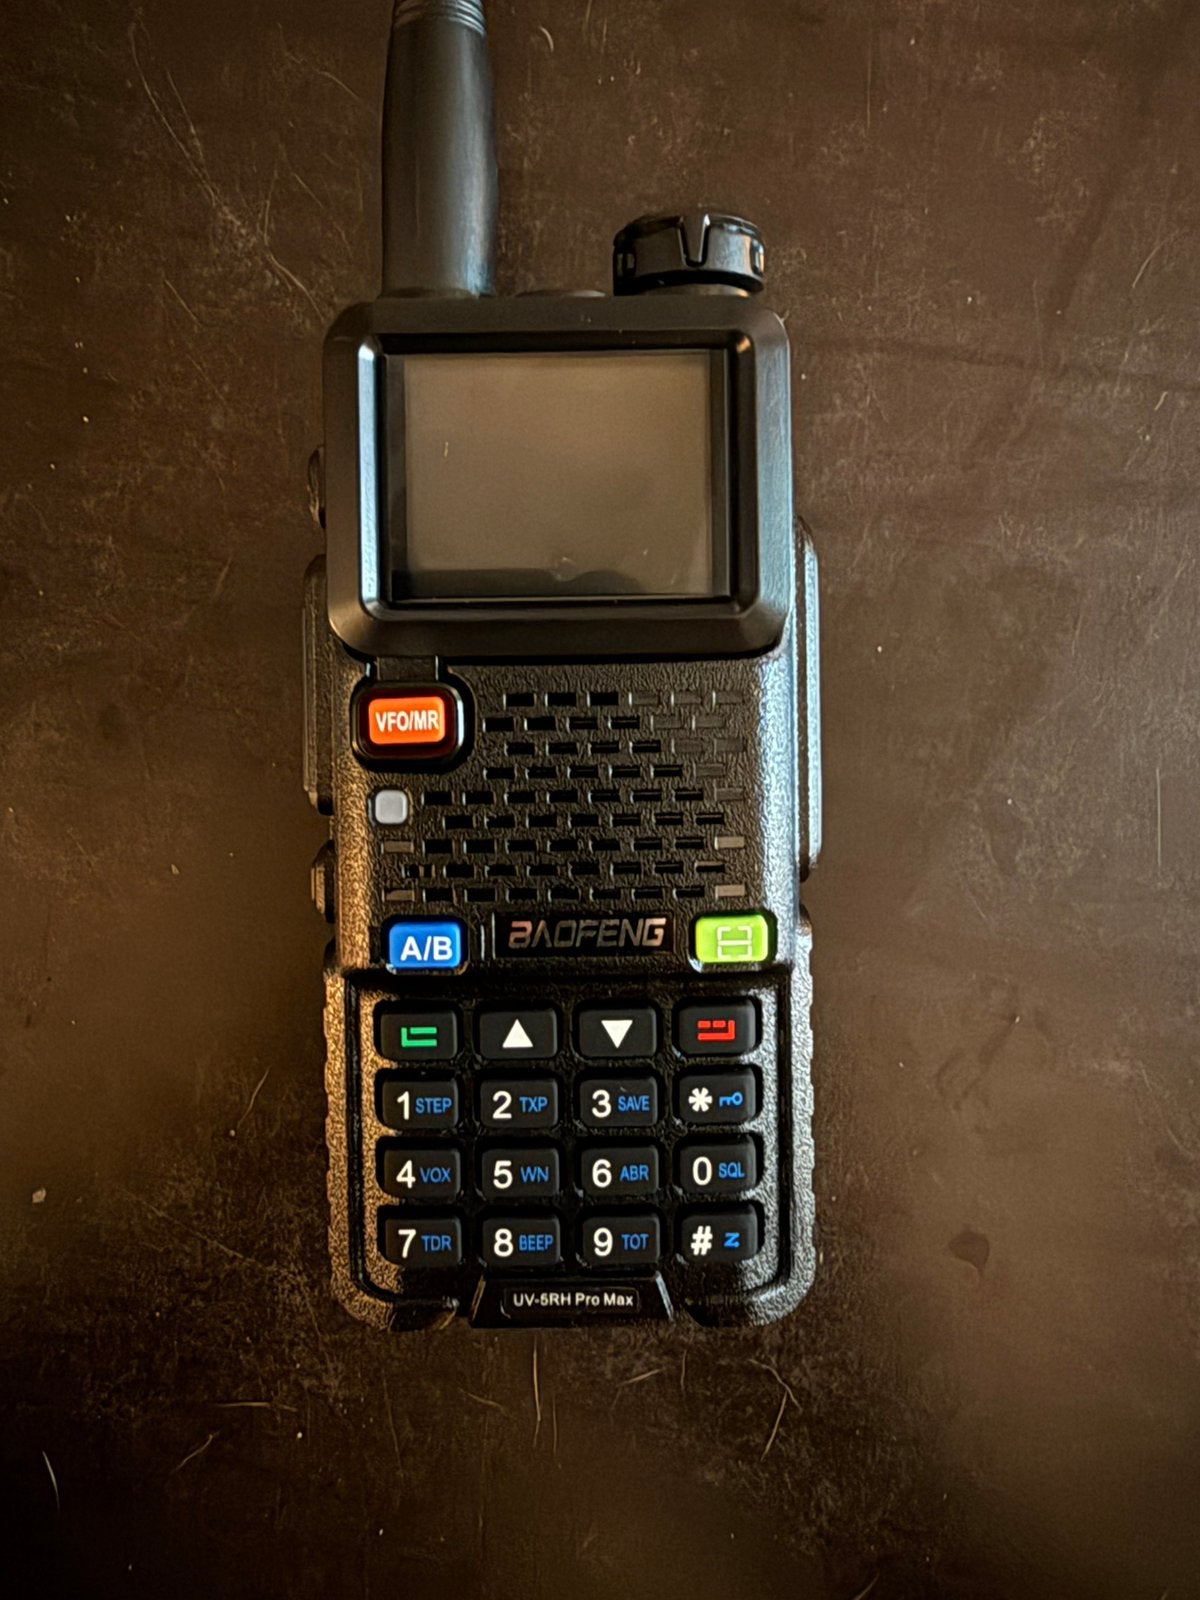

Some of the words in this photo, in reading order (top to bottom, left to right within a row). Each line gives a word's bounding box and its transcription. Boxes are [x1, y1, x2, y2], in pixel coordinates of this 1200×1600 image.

[375, 709, 439, 731] VFO/MR
[400, 936, 452, 961] A/B
[396, 1091, 411, 1120] 1
[415, 1097, 452, 1113] STEP
[492, 1091, 512, 1120] 2
[519, 1097, 548, 1113] TXP
[591, 1090, 612, 1118] 3
[618, 1095, 649, 1112] SAVE
[396, 1160, 416, 1188] 4
[420, 1167, 451, 1183] VOX
[493, 1160, 513, 1189] 5
[520, 1166, 549, 1182] WN
[592, 1159, 612, 1188] 6
[619, 1165, 649, 1181] ABR
[692, 1157, 712, 1185] 0
[718, 1162, 745, 1178] SQL
[398, 1229, 416, 1258] 7
[422, 1235, 452, 1251] TDR
[493, 1229, 514, 1257] 8
[519, 1235, 553, 1251] BEEP
[593, 1228, 613, 1256] 9
[621, 1234, 649, 1250] TOT
[513, 1293, 571, 1307] UV-5RH
[575, 1293, 600, 1306] Pro
[603, 1293, 633, 1306] Max
